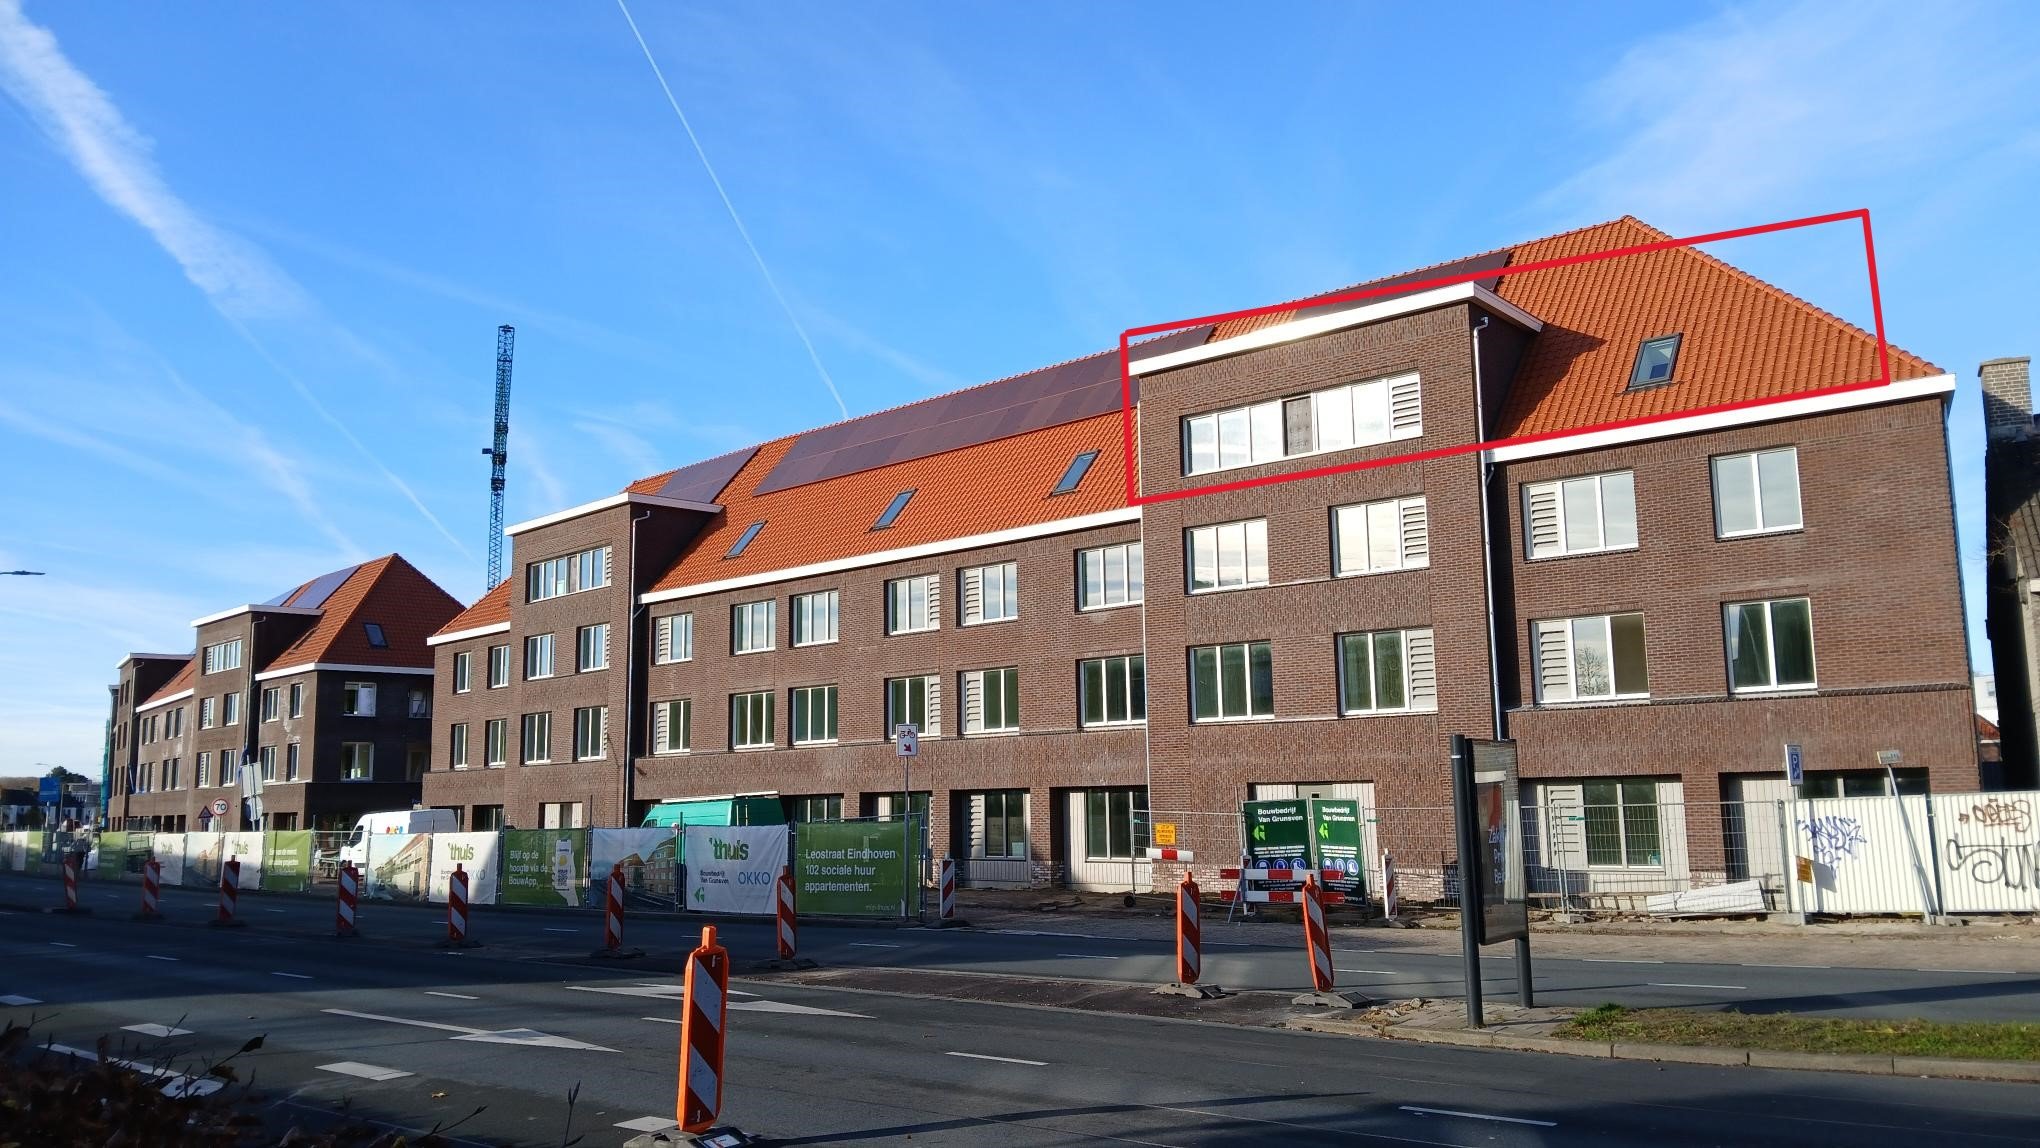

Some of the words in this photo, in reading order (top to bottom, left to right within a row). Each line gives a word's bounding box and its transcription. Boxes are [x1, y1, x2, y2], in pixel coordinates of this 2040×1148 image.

[215, 803, 227, 811] 70
[1257, 806, 1297, 815] Bouwbedrijf
[510, 850, 521, 861] Blijf
[522, 852, 530, 860] op
[531, 850, 539, 859] de
[805, 848, 845, 859] Leostraat
[847, 848, 896, 859] Eindhoven
[509, 863, 529, 874] hoogte
[530, 863, 540, 872] via
[540, 863, 548, 872] de
[805, 864, 819, 875] 102
[821, 864, 852, 876] sociale
[854, 864, 876, 876] huur
[738, 871, 771, 885] OKKO
[804, 880, 873, 894] appartementen.
